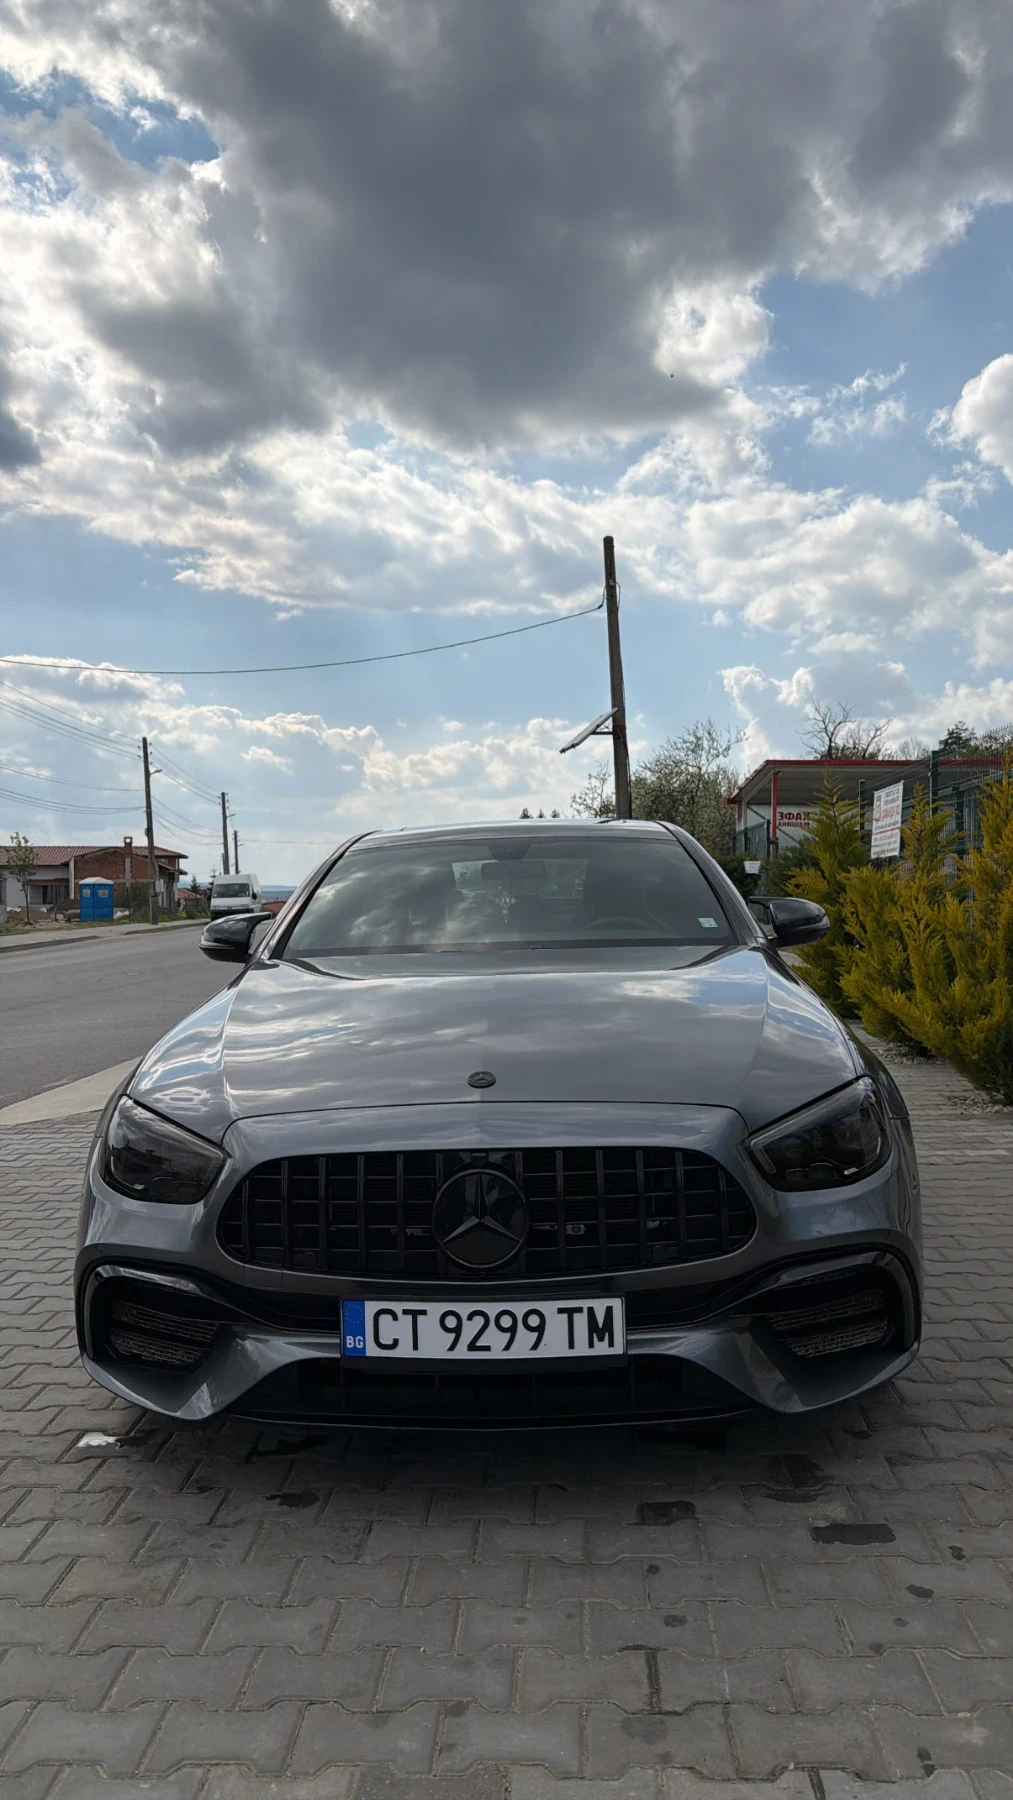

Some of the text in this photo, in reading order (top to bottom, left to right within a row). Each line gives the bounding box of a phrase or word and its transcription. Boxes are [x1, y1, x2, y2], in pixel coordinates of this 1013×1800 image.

[346, 1336, 364, 1348] BG
[373, 1306, 615, 1352] CT 9299 TM
